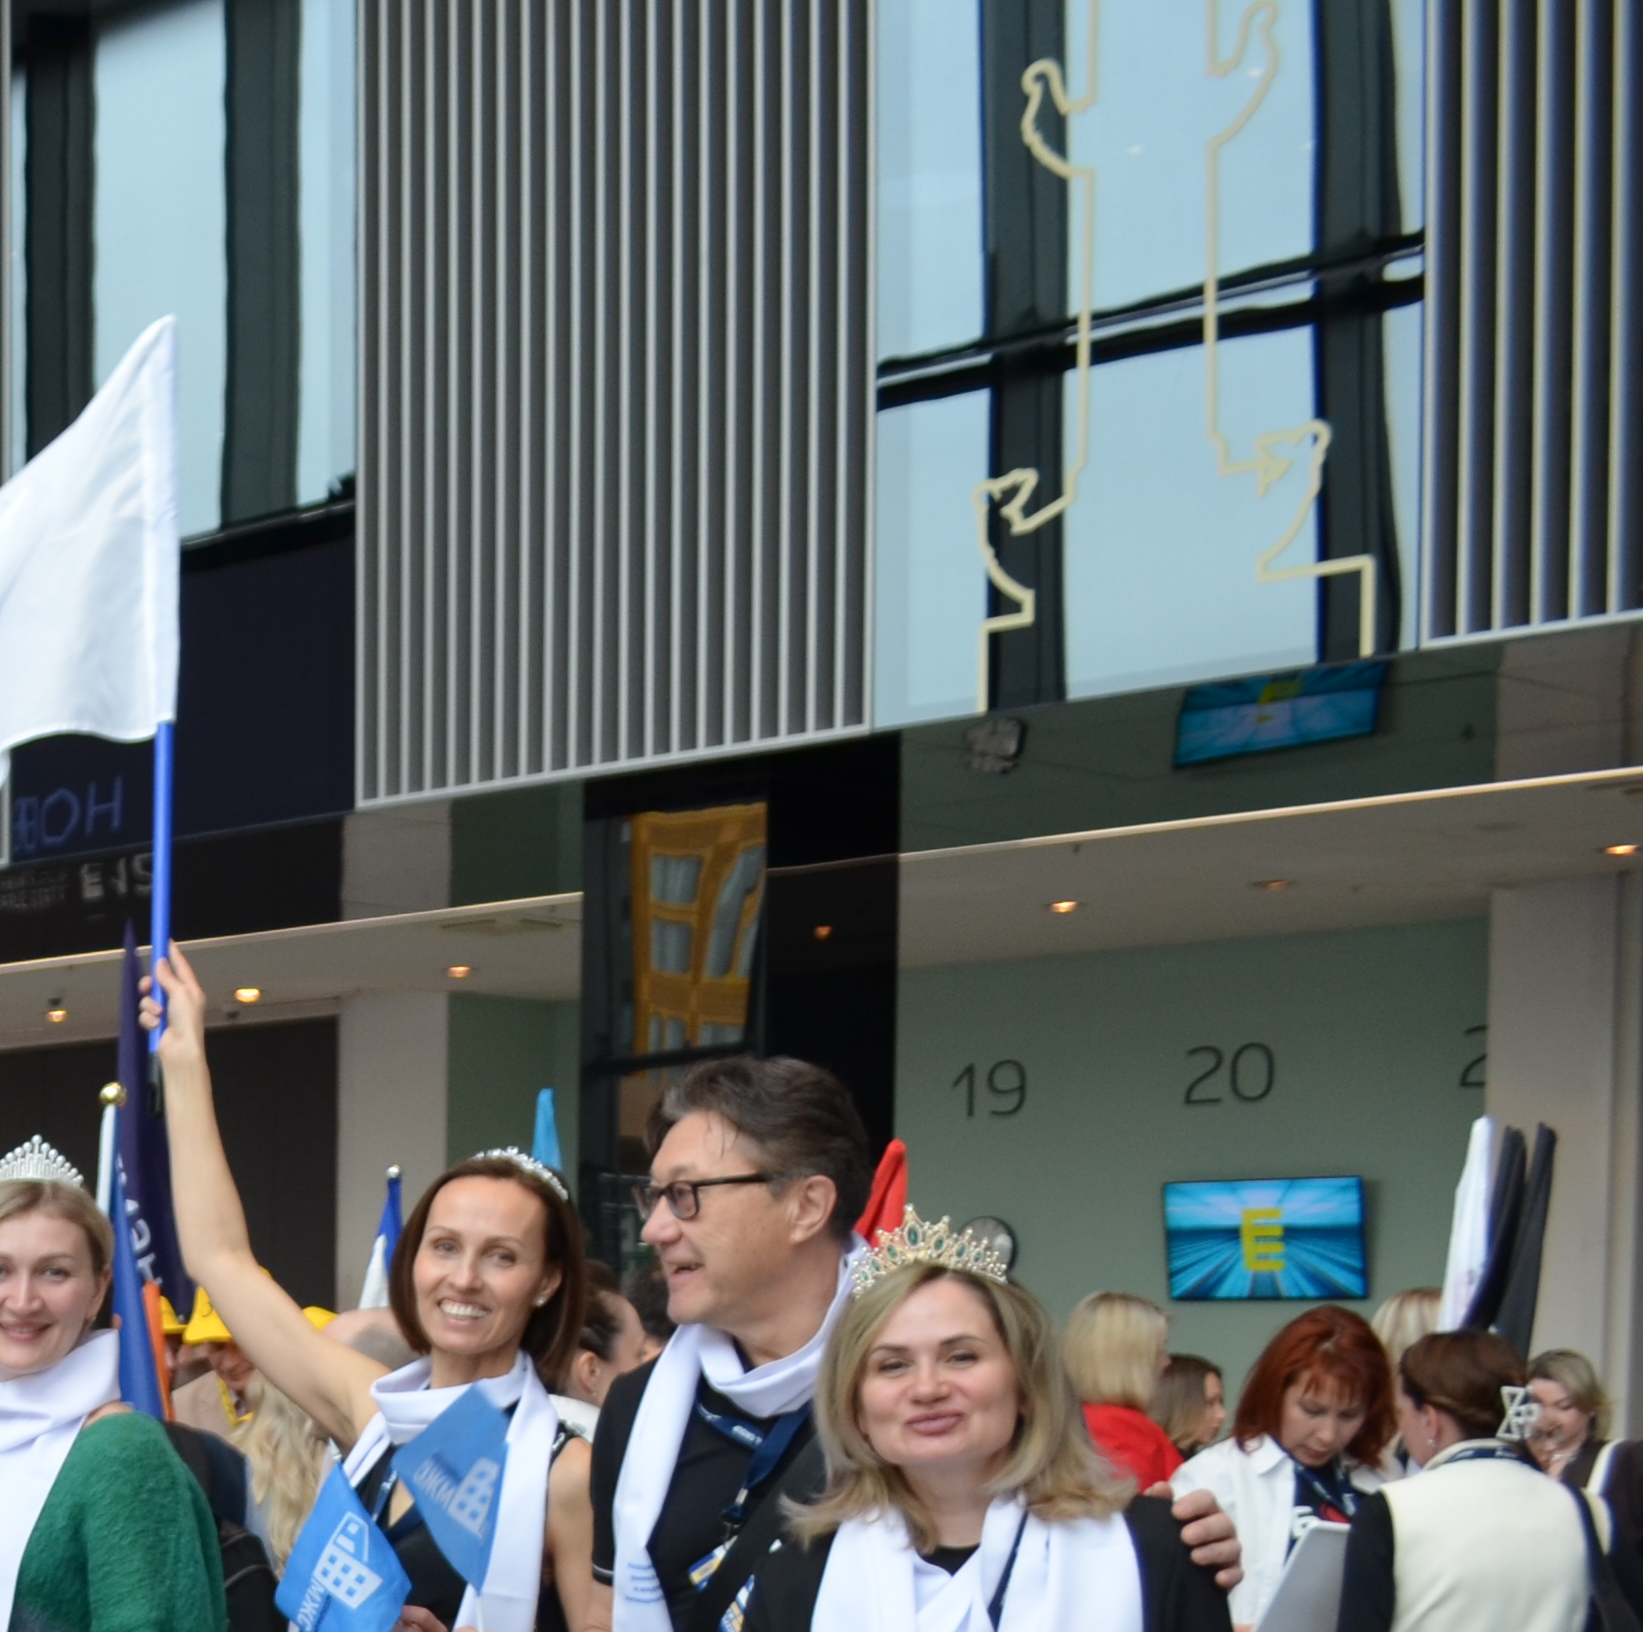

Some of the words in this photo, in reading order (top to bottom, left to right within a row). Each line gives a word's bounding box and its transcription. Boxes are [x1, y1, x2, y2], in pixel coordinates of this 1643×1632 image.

[952, 1059, 1028, 1118] 19
[1183, 1042, 1275, 1105] 20
[1459, 1025, 1488, 1088] 2
